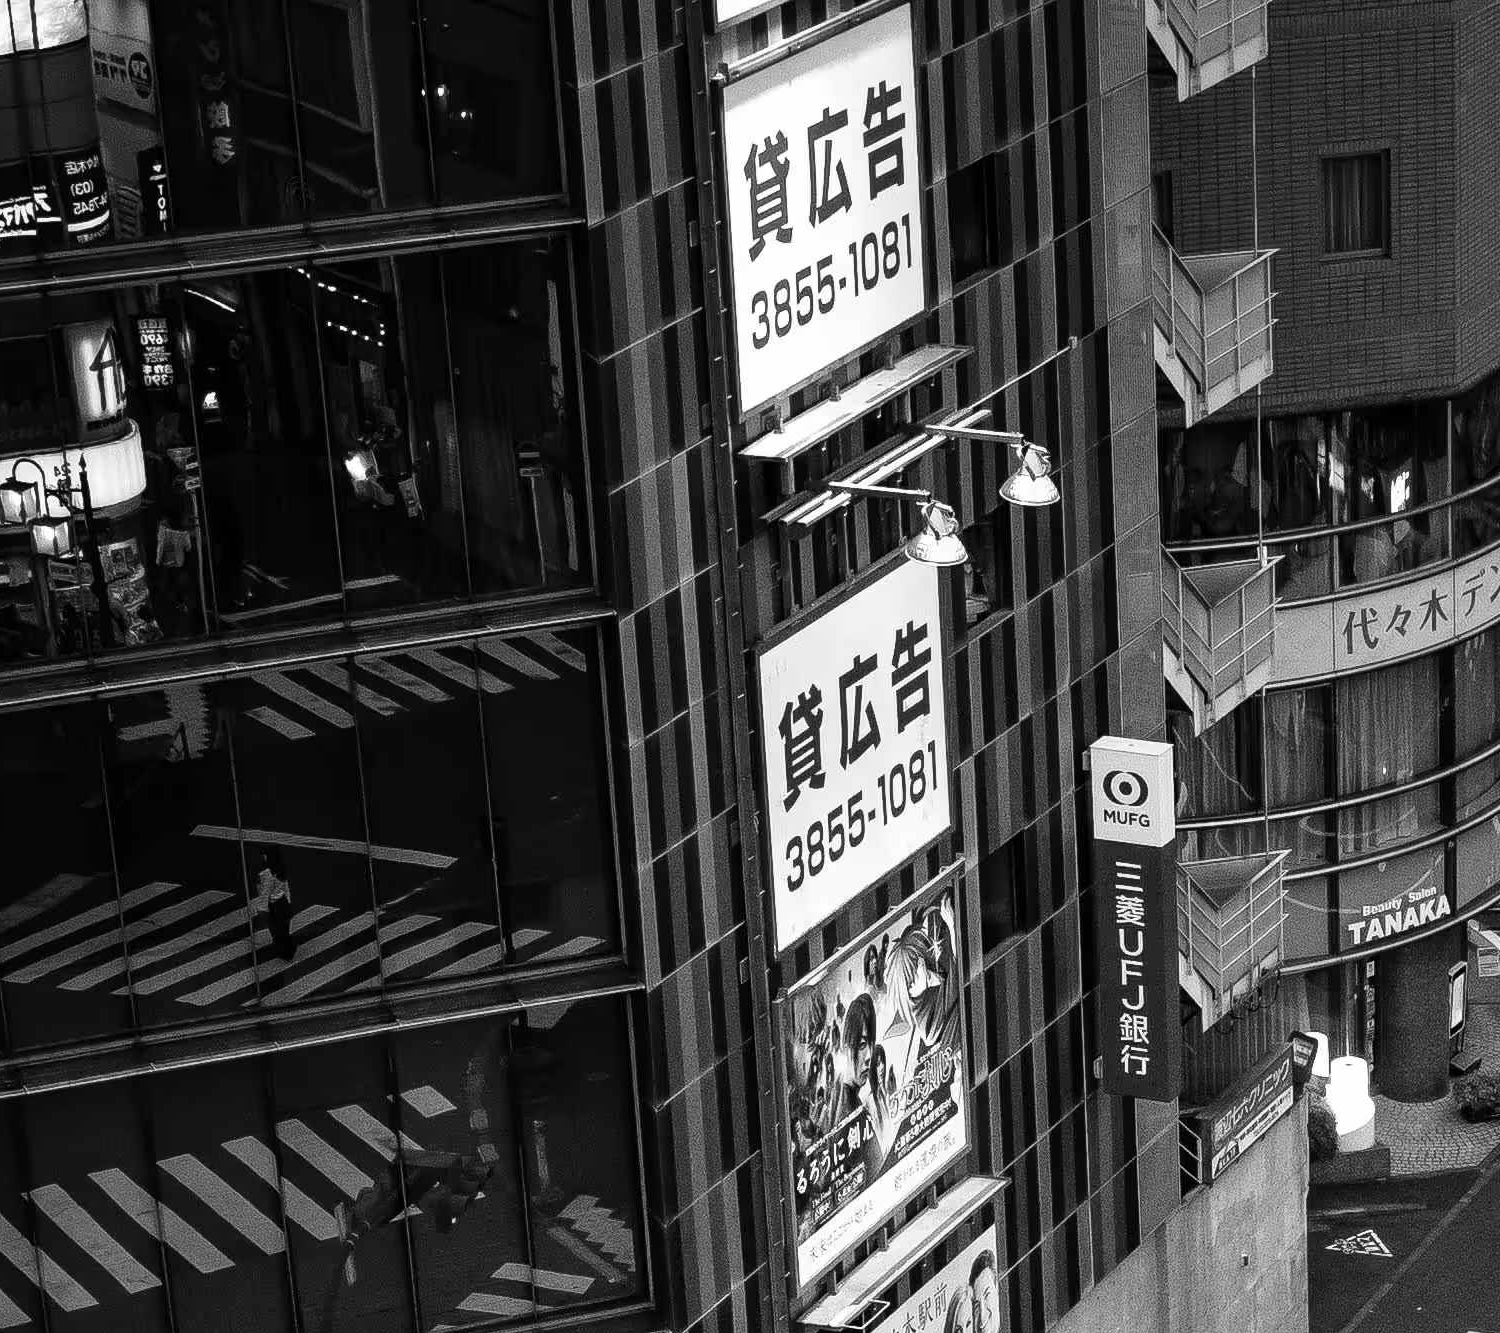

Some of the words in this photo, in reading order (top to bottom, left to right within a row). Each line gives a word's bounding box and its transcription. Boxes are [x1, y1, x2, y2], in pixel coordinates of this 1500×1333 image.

[744, 80, 907, 262] 貸広告
[750, 213, 913, 350] 3855-1081
[778, 620, 933, 813] 貸広告
[786, 740, 938, 893] 3855-1081
[1103, 809, 1150, 829] MUFG
[1115, 860, 1151, 1076] 三菱UFJ銀行
[1348, 895, 1451, 945] TANAKA
[1362, 898, 1402, 917] Beauty
[1408, 886, 1437, 904] Salon
